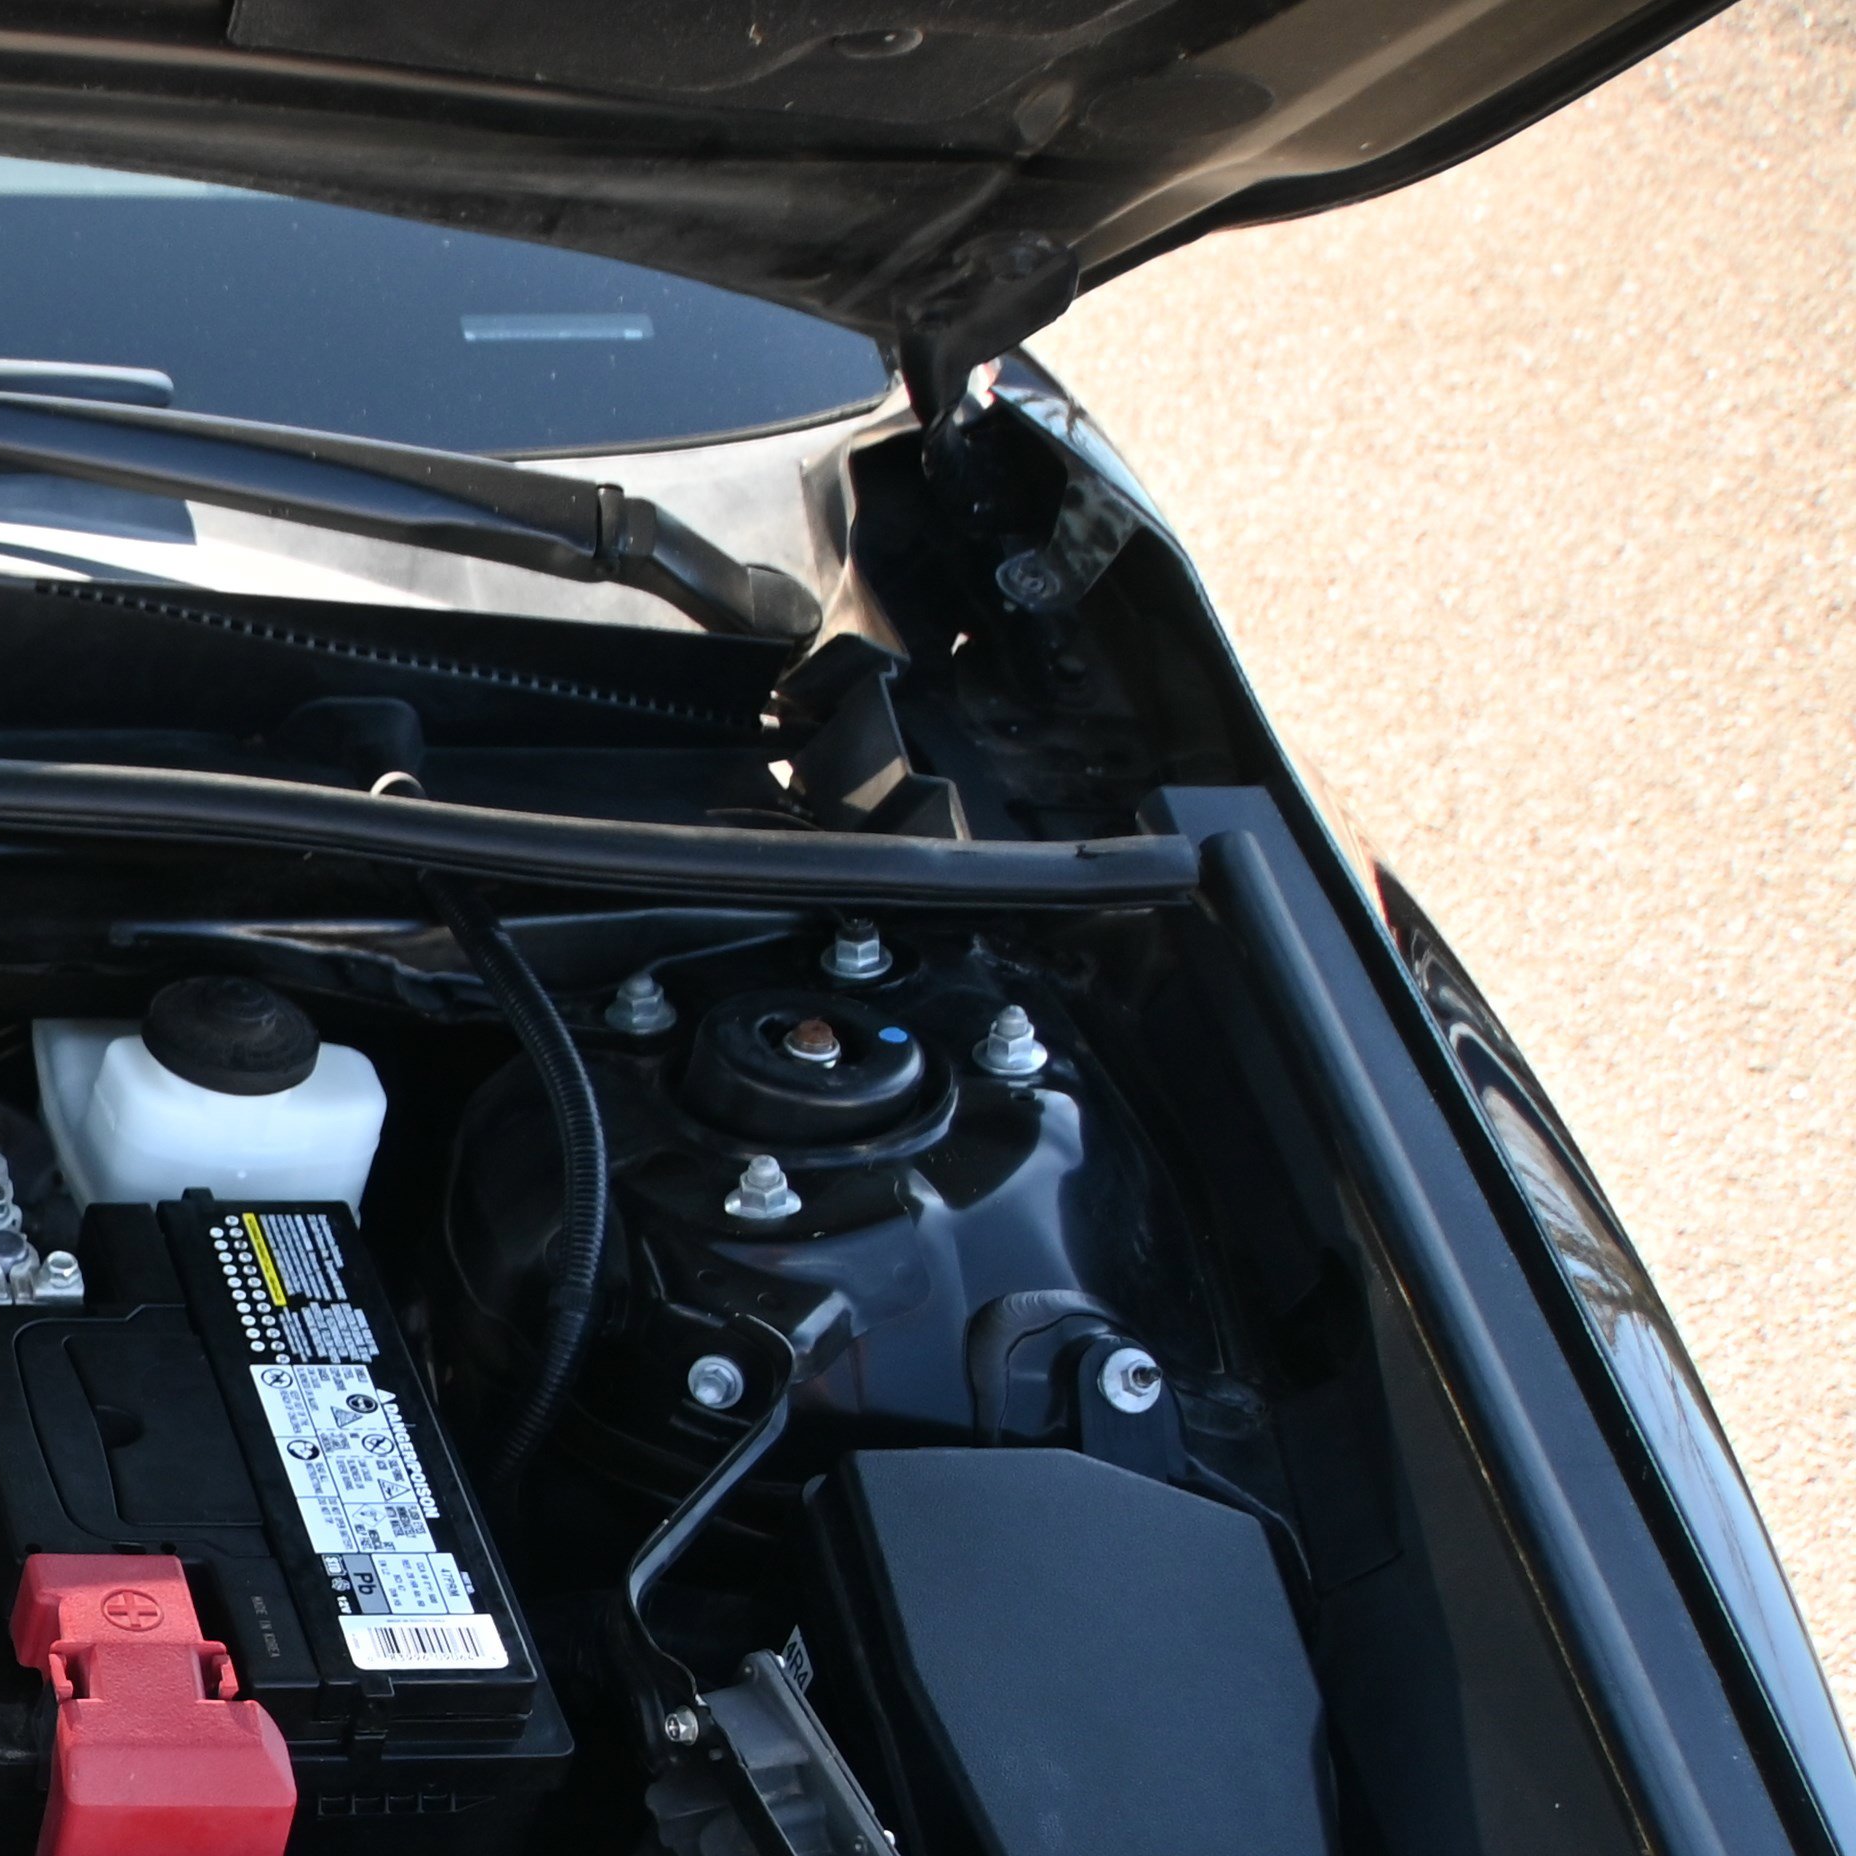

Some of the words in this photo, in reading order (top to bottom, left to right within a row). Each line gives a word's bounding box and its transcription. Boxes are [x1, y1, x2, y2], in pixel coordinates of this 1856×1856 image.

[382, 1403, 440, 1518] DANGER/POISON
[352, 1572, 379, 1594] Pb
[335, 1595, 352, 1613] 12V
